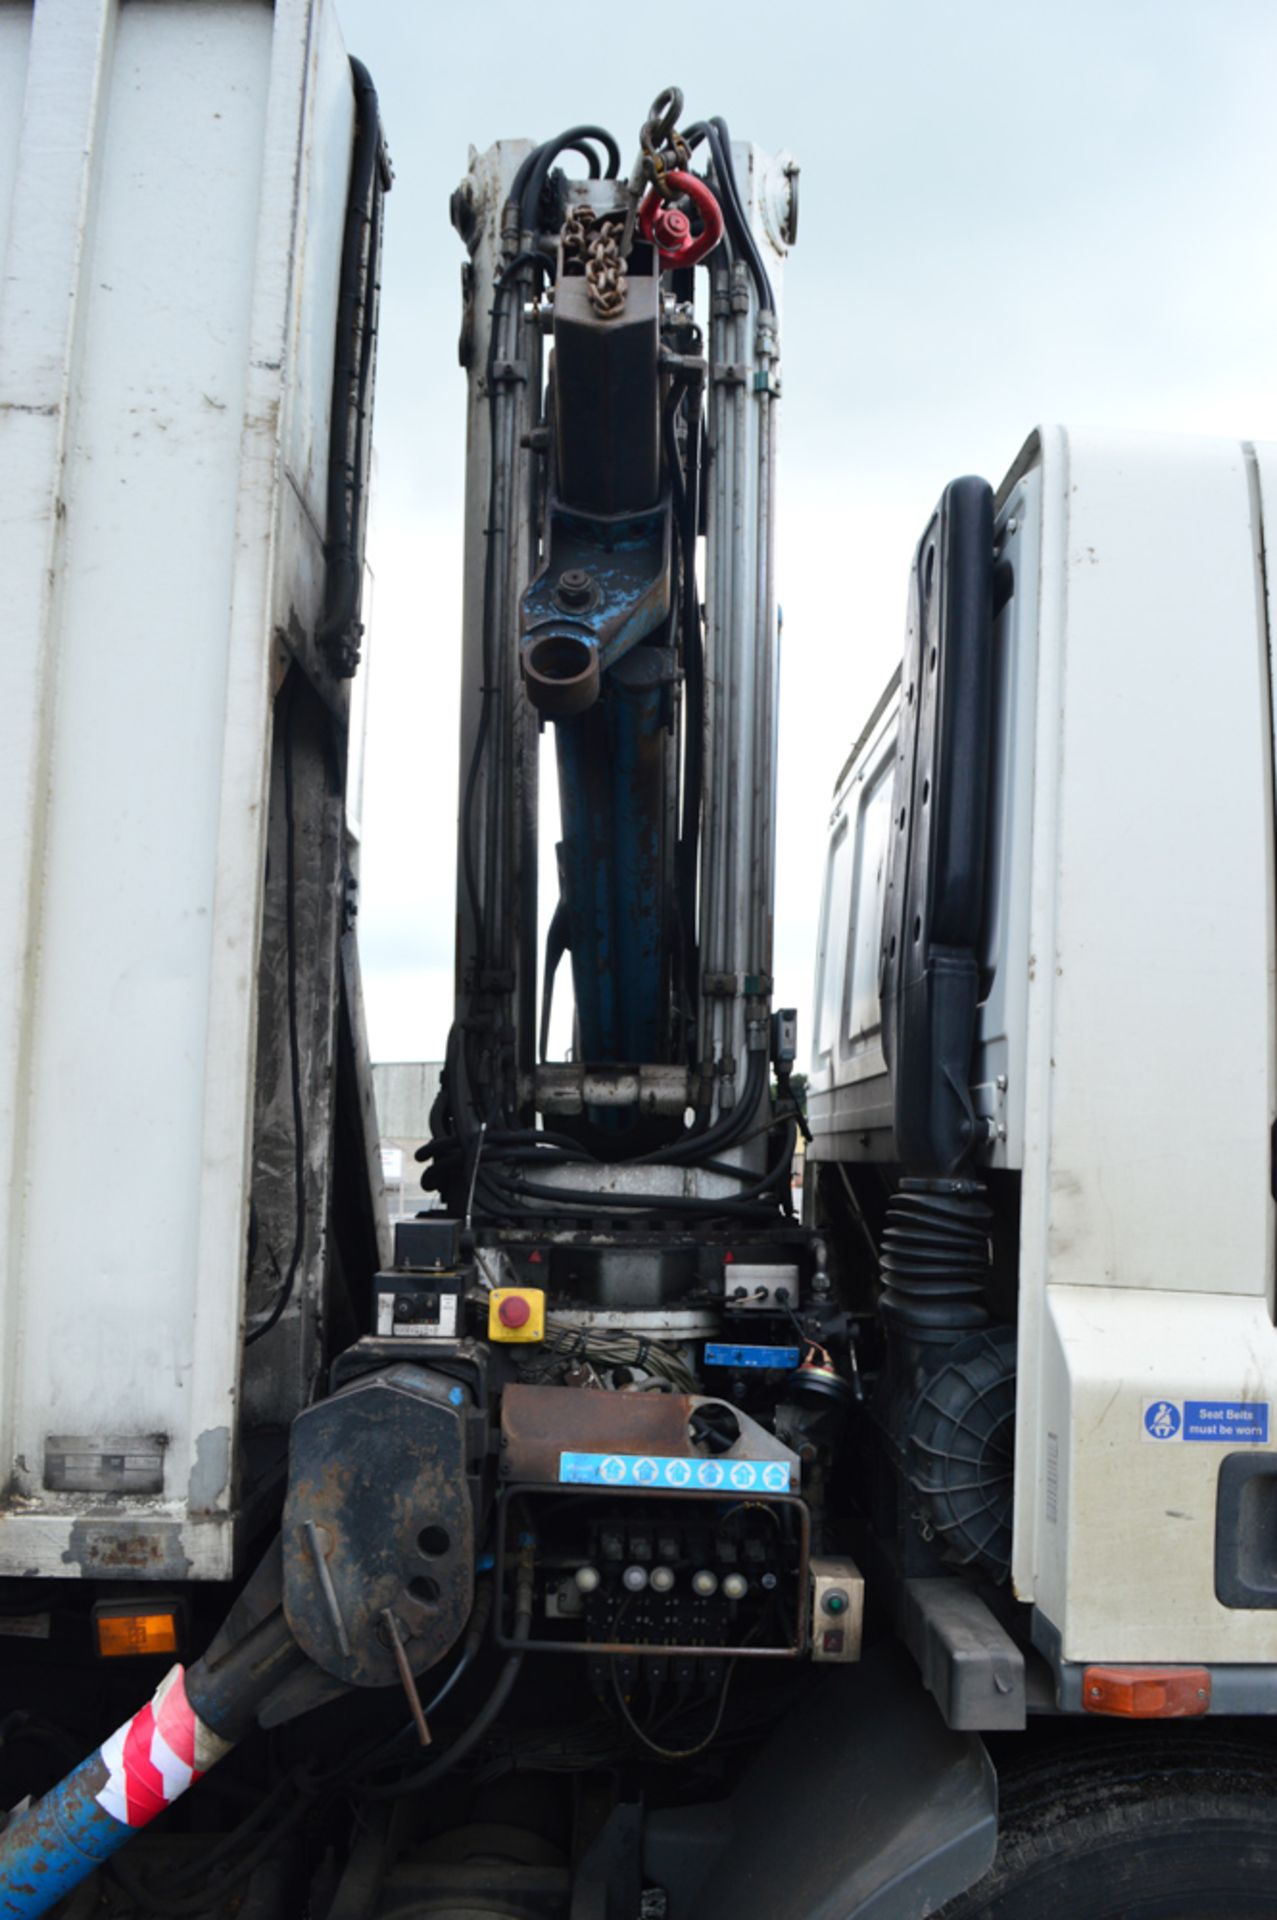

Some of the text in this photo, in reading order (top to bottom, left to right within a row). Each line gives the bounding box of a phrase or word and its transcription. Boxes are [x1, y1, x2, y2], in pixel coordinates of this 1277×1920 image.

[1199, 1408, 1254, 1421] Seat Belts
[1189, 1424, 1263, 1437] must be worn
